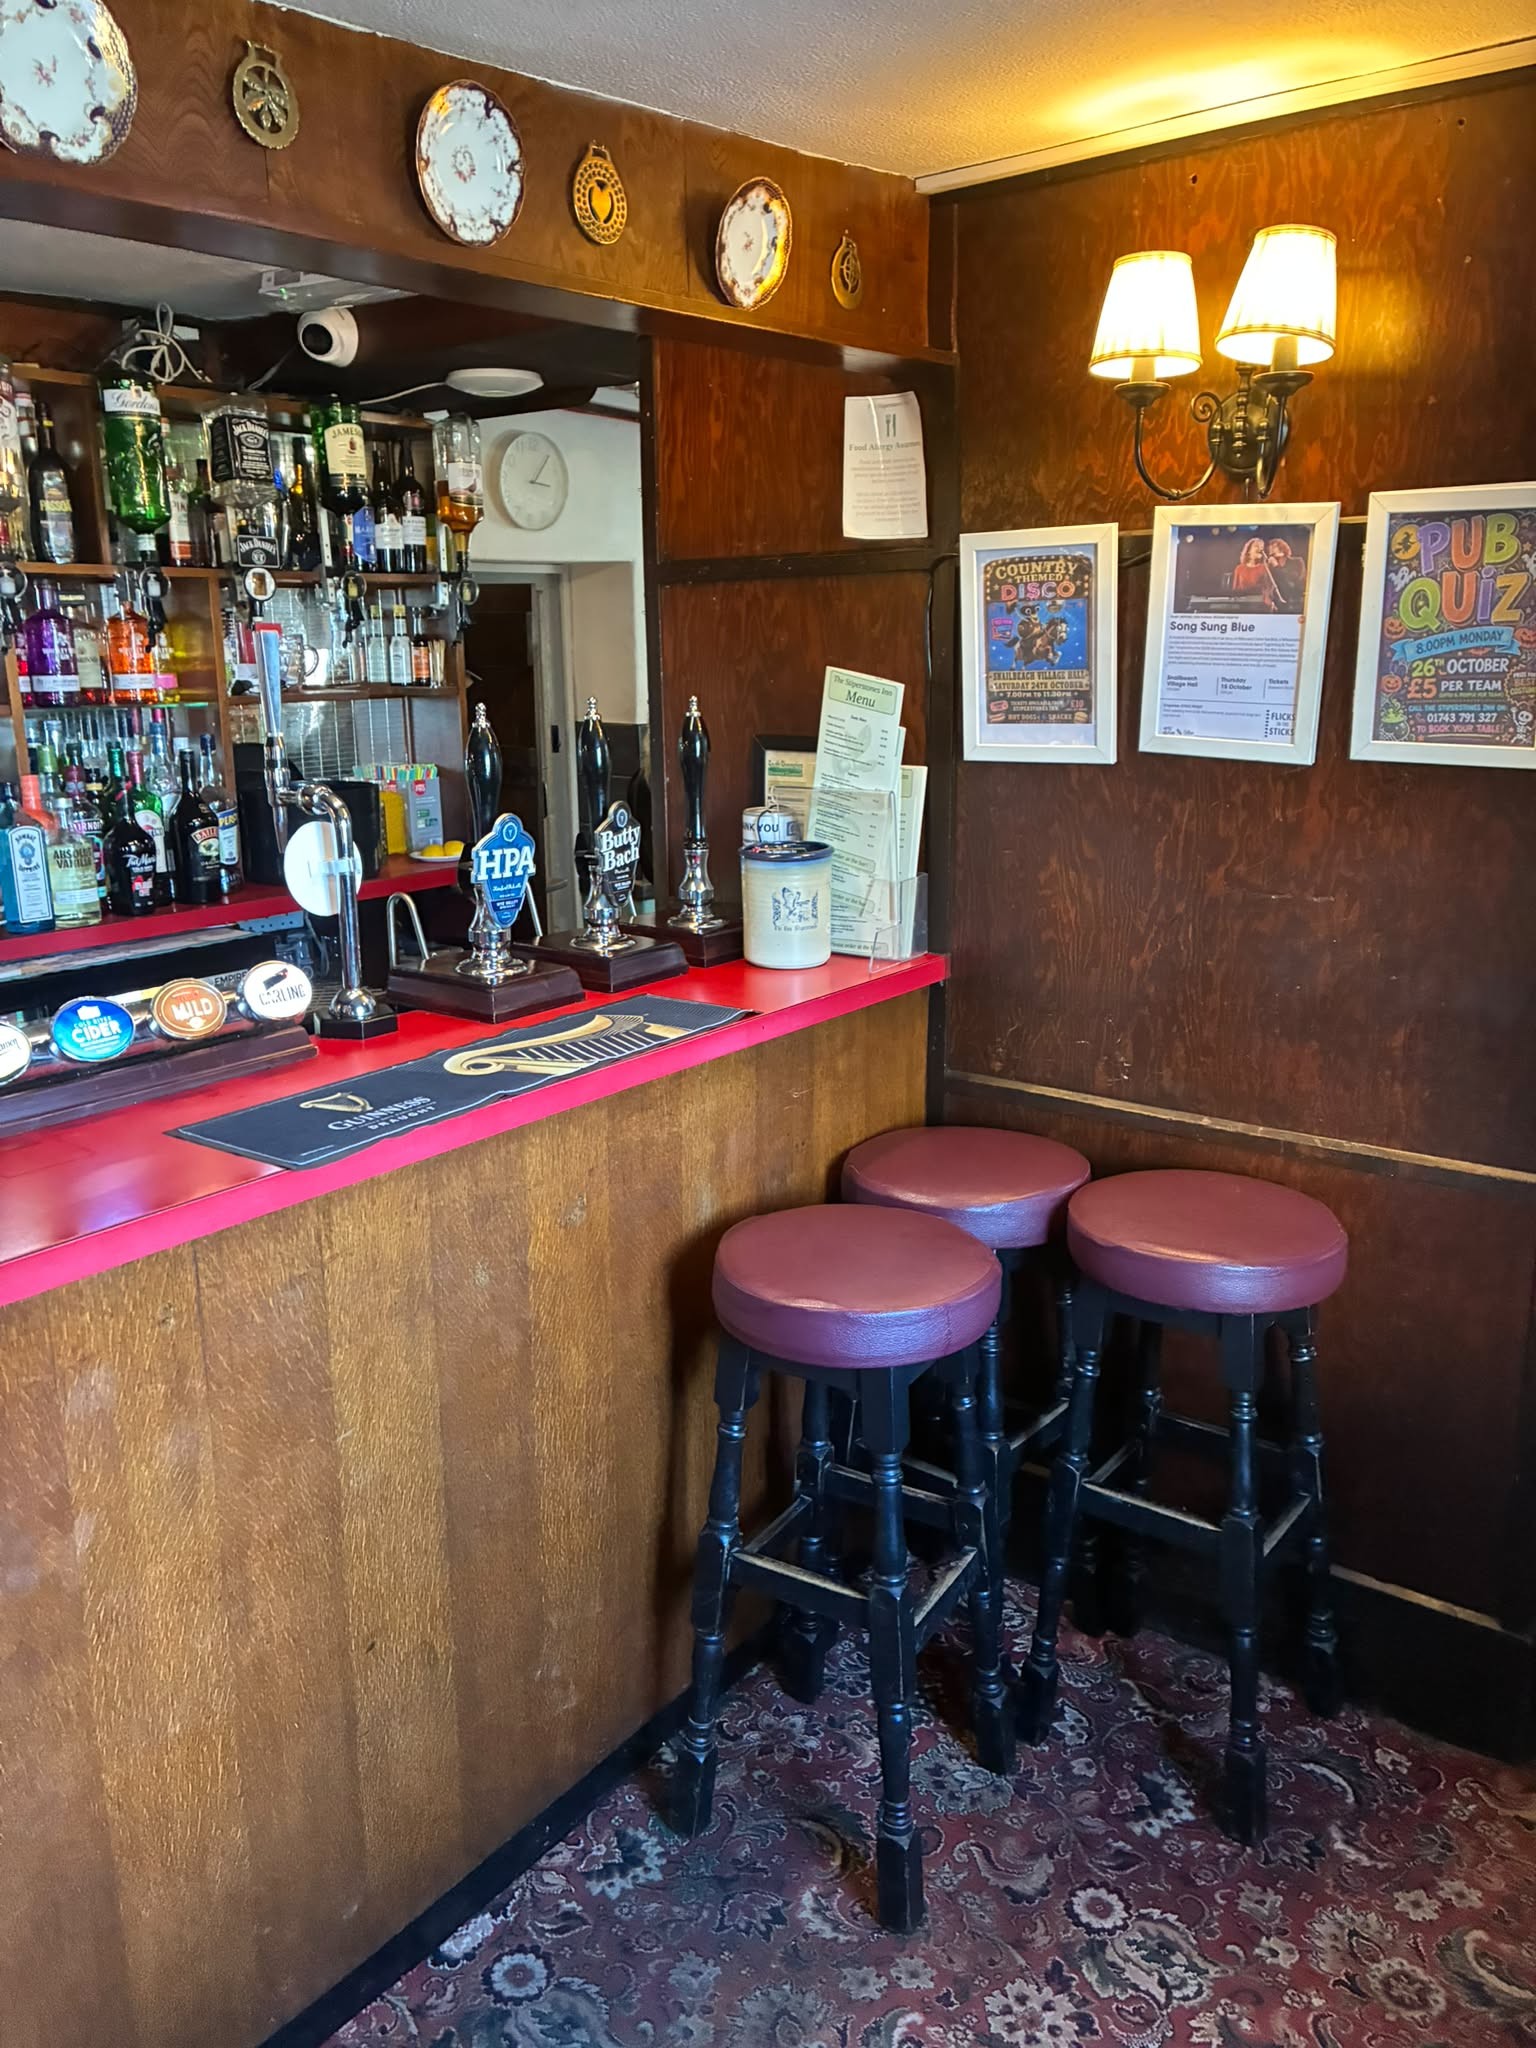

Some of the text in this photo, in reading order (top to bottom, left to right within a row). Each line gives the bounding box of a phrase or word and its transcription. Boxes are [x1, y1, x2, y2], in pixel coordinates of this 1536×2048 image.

[849, 443, 867, 452] Food
[1417, 512, 1521, 576] PUB
[995, 559, 1078, 579] COUNTRY
[1014, 573, 1063, 583] THEMED
[1001, 581, 1076, 601] DISCO
[1170, 621, 1255, 634] Song Sung Blue
[1415, 630, 1504, 654] 8.00PM MONDAY
[1446, 657, 1509, 674] OCTOBER
[1050, 681, 1083, 689] OCTOBER
[1407, 678, 1438, 699] £5
[1441, 680, 1463, 691] PER
[1467, 680, 1502, 691] TEAM
[846, 690, 876, 707] Menu
[1271, 712, 1296, 721] FLICKS
[1427, 712, 1497, 723] 01743 791 327
[1269, 727, 1295, 737] STICKS
[1453, 724, 1474, 732] YOUR
[758, 824, 779, 832] YOU
[600, 825, 641, 853] Butty
[478, 845, 537, 881] HPA
[602, 843, 640, 872] Bach
[259, 984, 306, 1006] CARLING
[171, 998, 213, 1021] MILD
[71, 1020, 122, 1044] CIDER
[327, 1096, 432, 1131] GUINNESS
[367, 1106, 436, 1130] DRAUGHT
